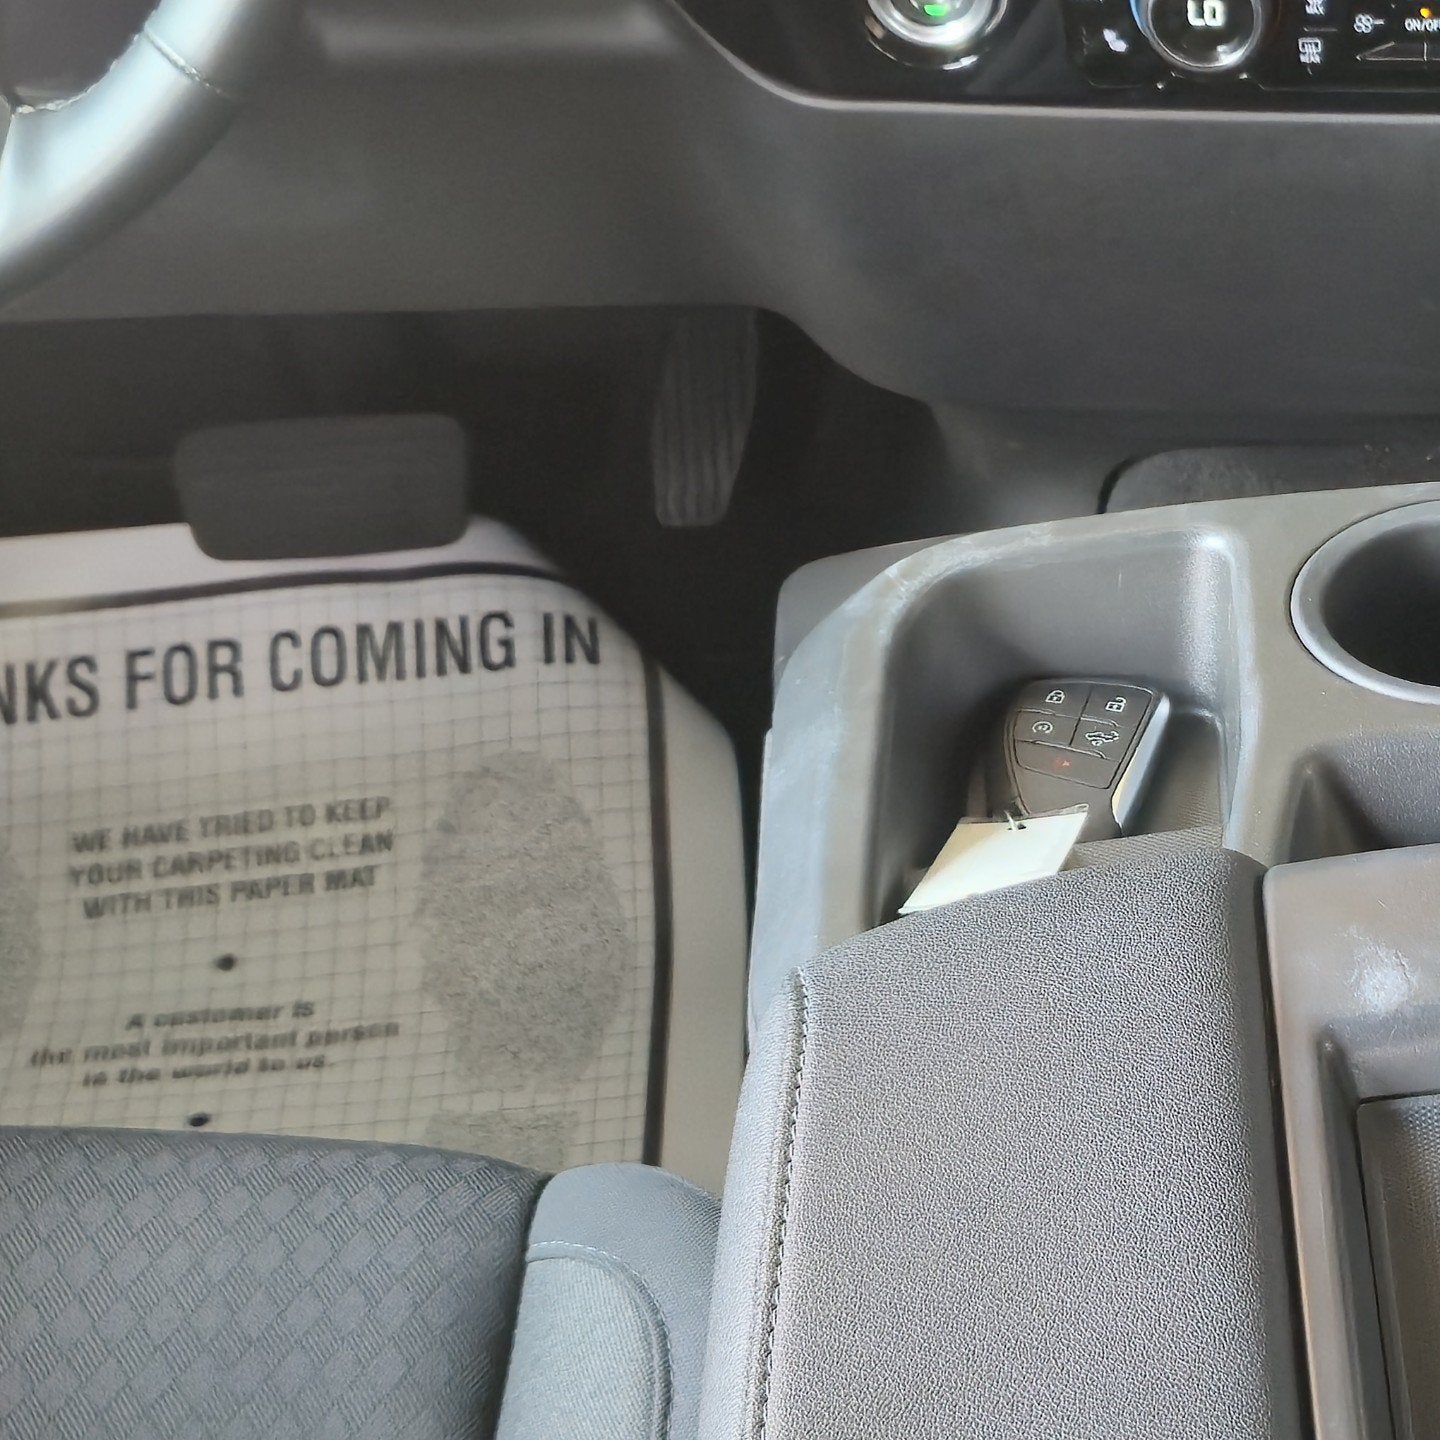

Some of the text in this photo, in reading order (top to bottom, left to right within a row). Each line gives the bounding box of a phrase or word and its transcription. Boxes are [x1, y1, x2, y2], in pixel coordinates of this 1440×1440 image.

[126, 638, 244, 711] FOR
[270, 610, 516, 692] COMING
[541, 611, 601, 666] IN
[71, 796, 391, 853] WE HAVE TRIED TO KEEP
[67, 828, 394, 887] YOUR CARPETING CLEAN
[83, 864, 377, 920] WITH THIS PAPER MAT
